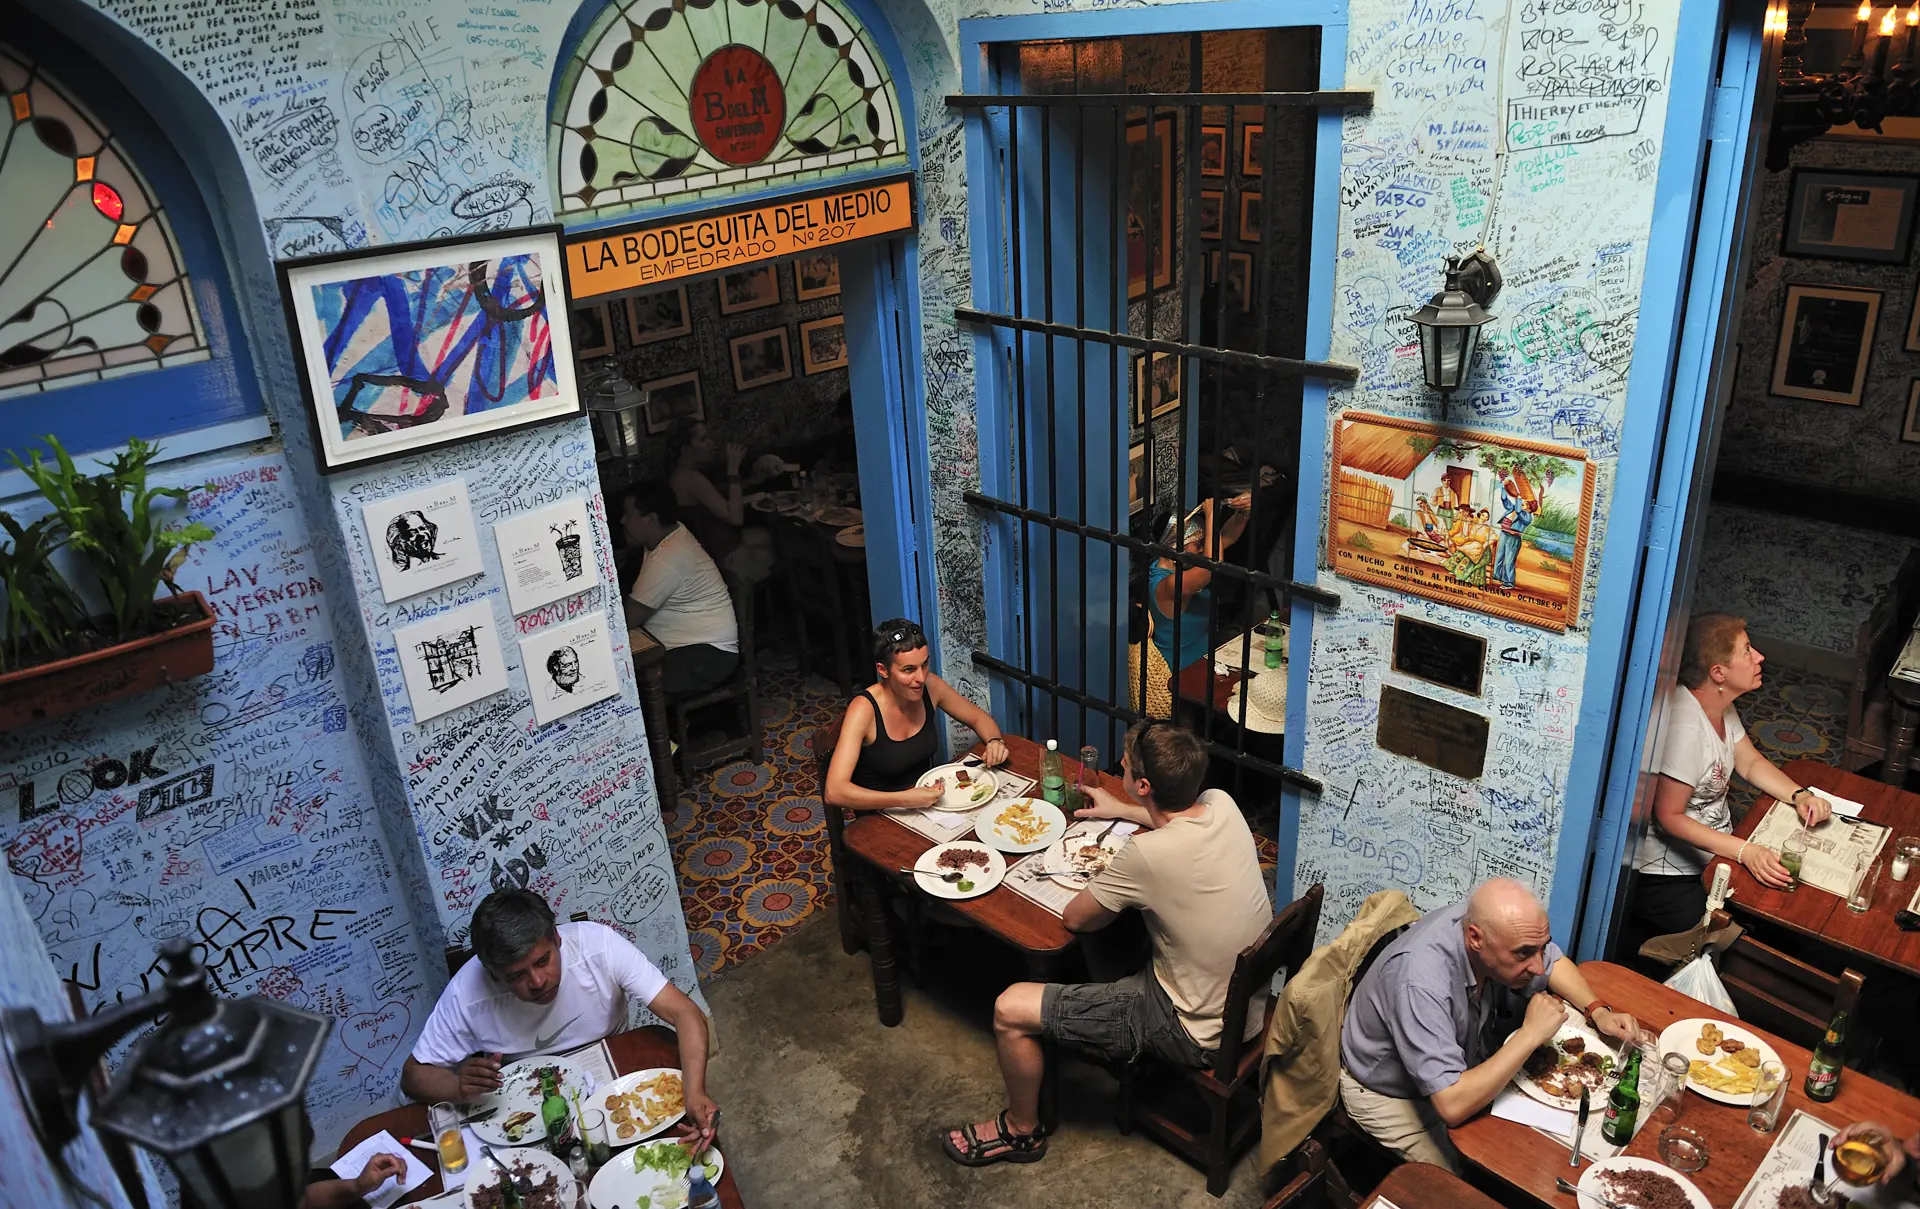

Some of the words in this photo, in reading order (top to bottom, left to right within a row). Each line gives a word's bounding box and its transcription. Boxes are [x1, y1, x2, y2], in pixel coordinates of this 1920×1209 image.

[724, 66, 747, 88] LA
[218, 89, 248, 106] MARE
[1510, 103, 1576, 126] THIERRY
[715, 120, 765, 139] EMPEDRADO
[1576, 125, 1606, 140] 2008
[1375, 190, 1427, 206] PABLO
[581, 241, 619, 274] LA
[622, 211, 766, 266] BODEGUITA
[775, 203, 819, 235] DEL
[823, 188, 892, 226] MEDIO
[1384, 225, 1415, 238] ANA
[640, 240, 777, 281] EMPEDRADO
[816, 222, 857, 244] 207
[480, 485, 563, 526] SAHUAYO
[1338, 550, 1353, 559] CON
[1356, 554, 1385, 567] MUCHO
[1394, 563, 1424, 576] CARIÑO
[1431, 573, 1442, 581] AL
[1444, 575, 1473, 588] PUEBLO
[1478, 585, 1511, 598] CUBANO
[1517, 593, 1550, 608] OCTUBRE
[1552, 602, 1563, 611] 95
[1366, 567, 1393, 578] DONADO
[1500, 647, 1542, 667] CIP
[433, 808, 468, 846] CHILE
[1481, 853, 1523, 875] ISMAEL
[355, 1011, 396, 1033] THOMAS
